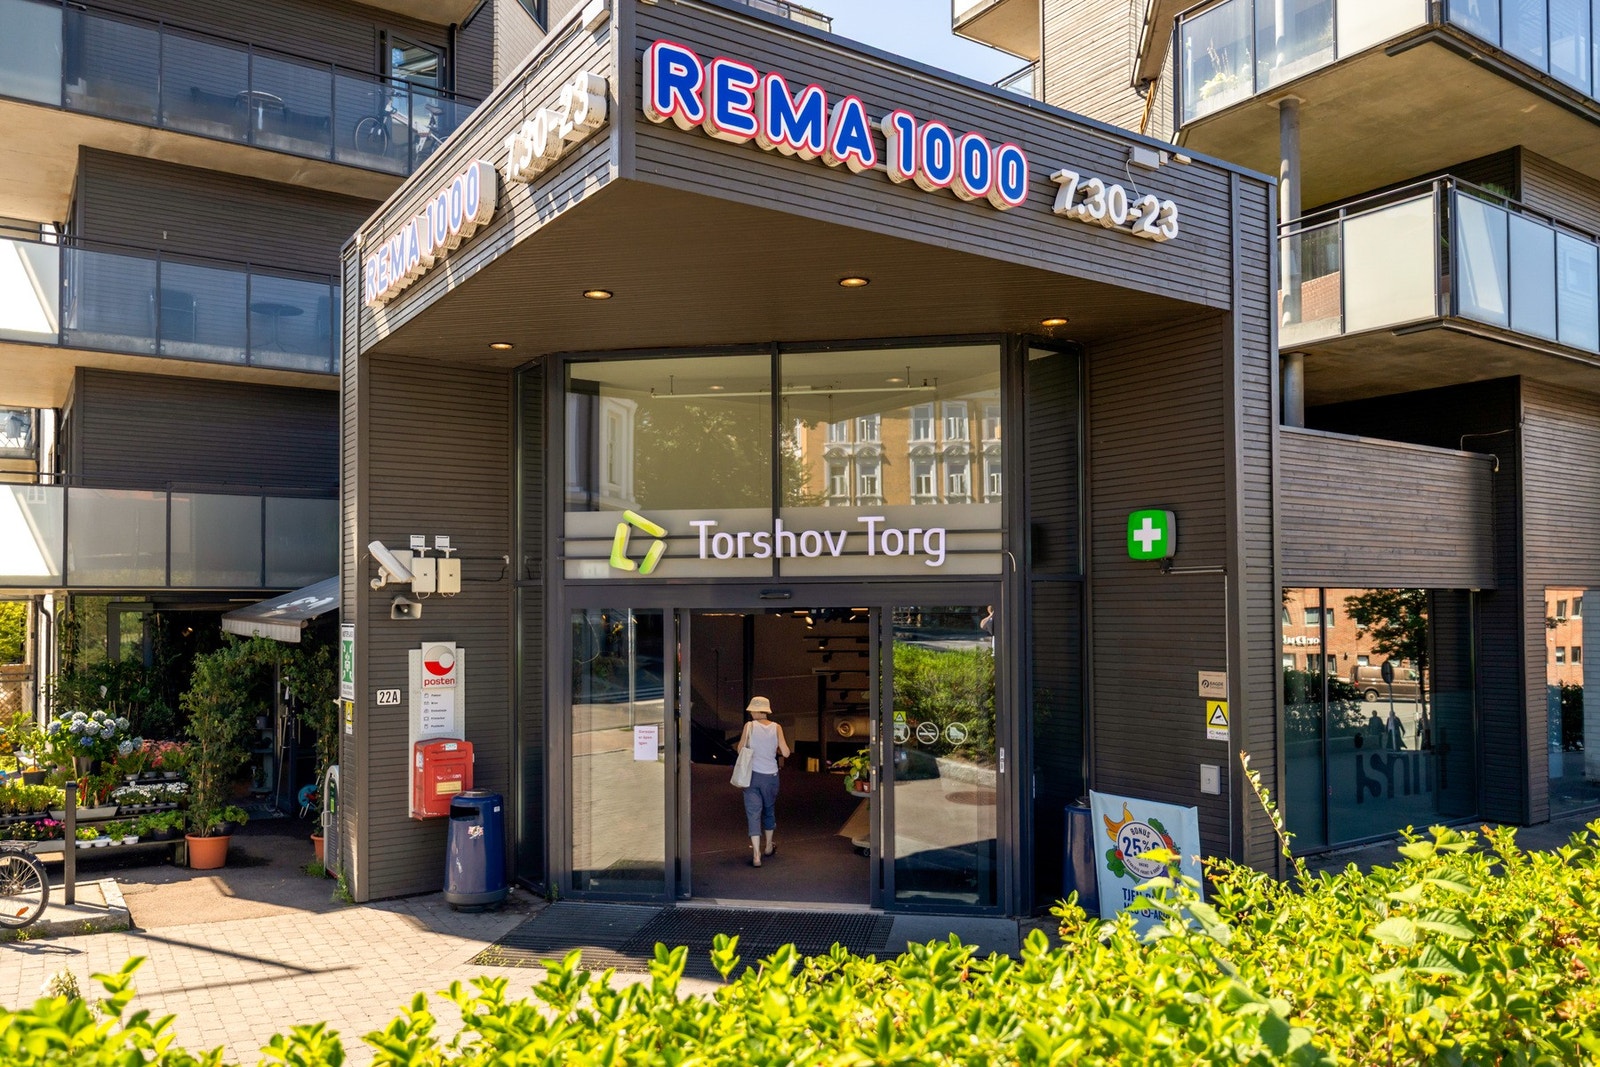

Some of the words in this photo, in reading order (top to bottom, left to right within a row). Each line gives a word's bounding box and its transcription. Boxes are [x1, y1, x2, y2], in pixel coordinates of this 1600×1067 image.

[505, 70, 593, 183] 7.30-23
[647, 39, 878, 172] REMA
[886, 109, 1030, 209] 1000
[365, 214, 421, 306] REMA
[426, 158, 482, 256] 1000
[1050, 168, 1179, 241] 7.30-23
[689, 517, 848, 560] Torshov
[857, 515, 947, 568] Torg
[379, 690, 398, 704] 22A
[424, 677, 455, 687] posten
[1130, 827, 1151, 838] BONUS
